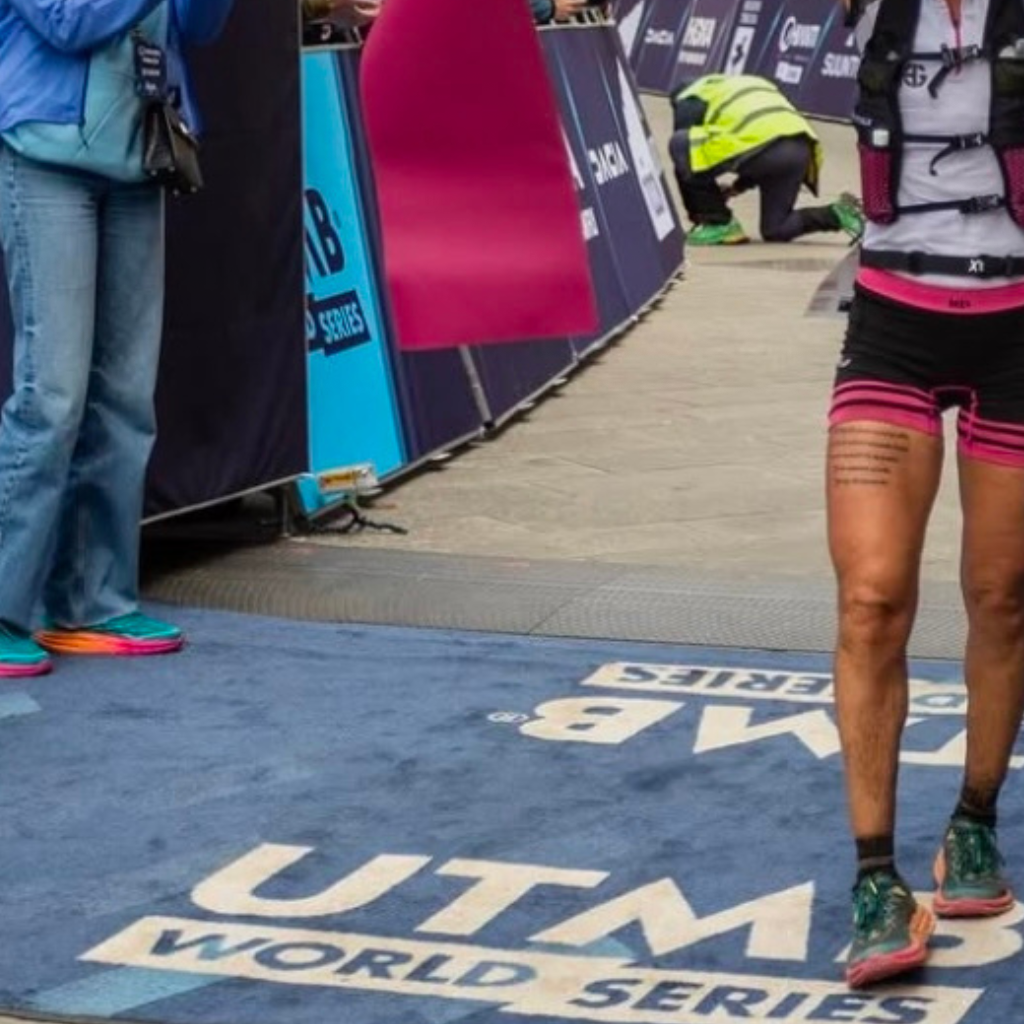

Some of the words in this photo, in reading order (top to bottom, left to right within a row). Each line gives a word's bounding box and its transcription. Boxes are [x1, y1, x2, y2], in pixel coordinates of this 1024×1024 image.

[317, 302, 366, 345] SERIES
[149, 929, 539, 989] WORLD
[566, 978, 936, 1024] SERIES
